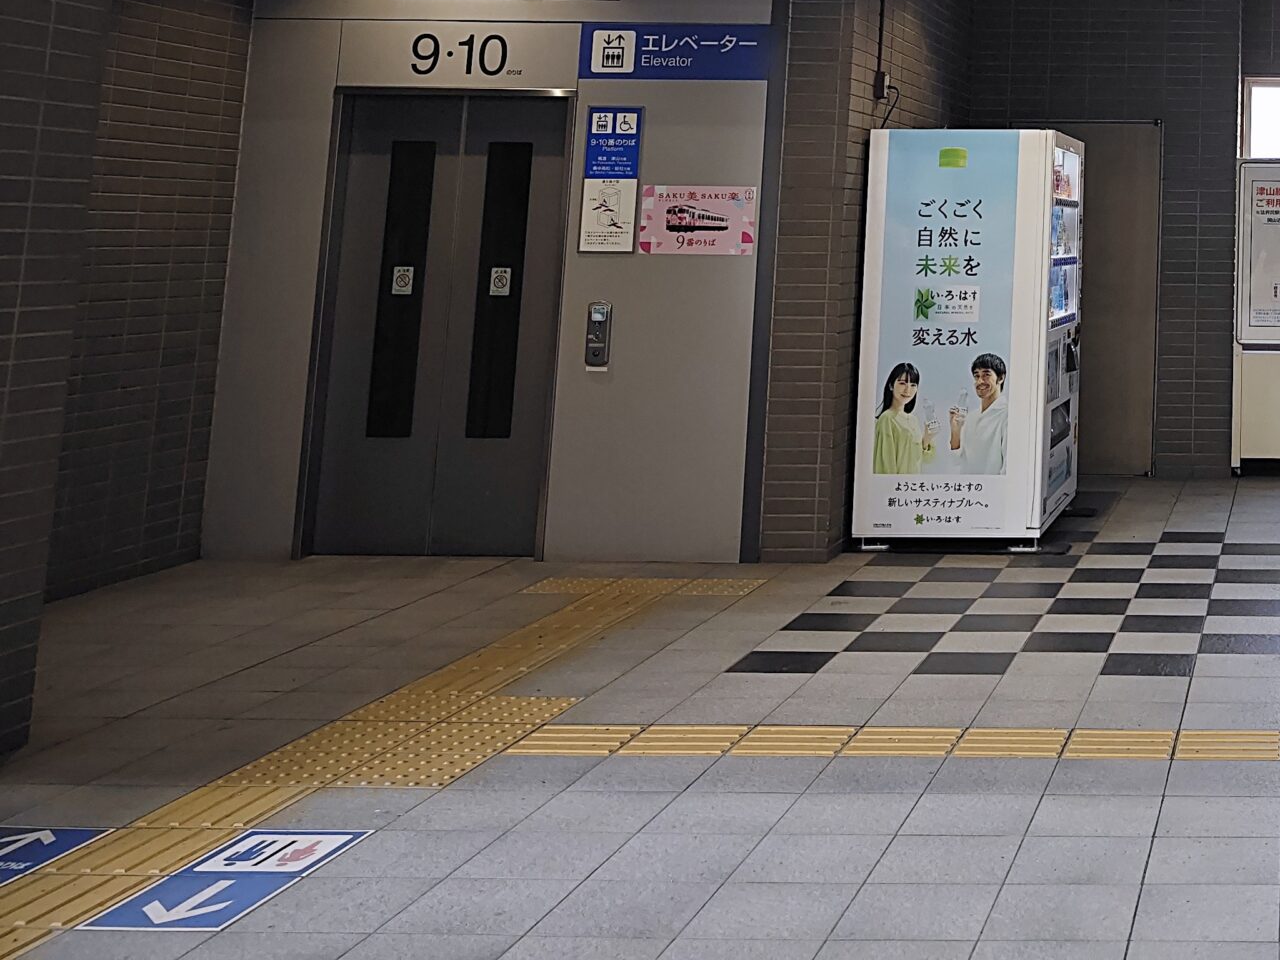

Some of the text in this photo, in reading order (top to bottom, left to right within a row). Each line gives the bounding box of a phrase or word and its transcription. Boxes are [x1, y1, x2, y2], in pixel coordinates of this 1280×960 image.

[641, 35, 759, 53] エレベーター
[641, 55, 693, 68] Elevator
[918, 199, 983, 219] ごくごく
[676, 234, 718, 250] 9番のりば
[917, 226, 982, 247] 自然に
[915, 254, 981, 277] 未来を
[912, 326, 978, 347] 変える水
[888, 497, 989, 509] 新しいサスティナブルへ。
